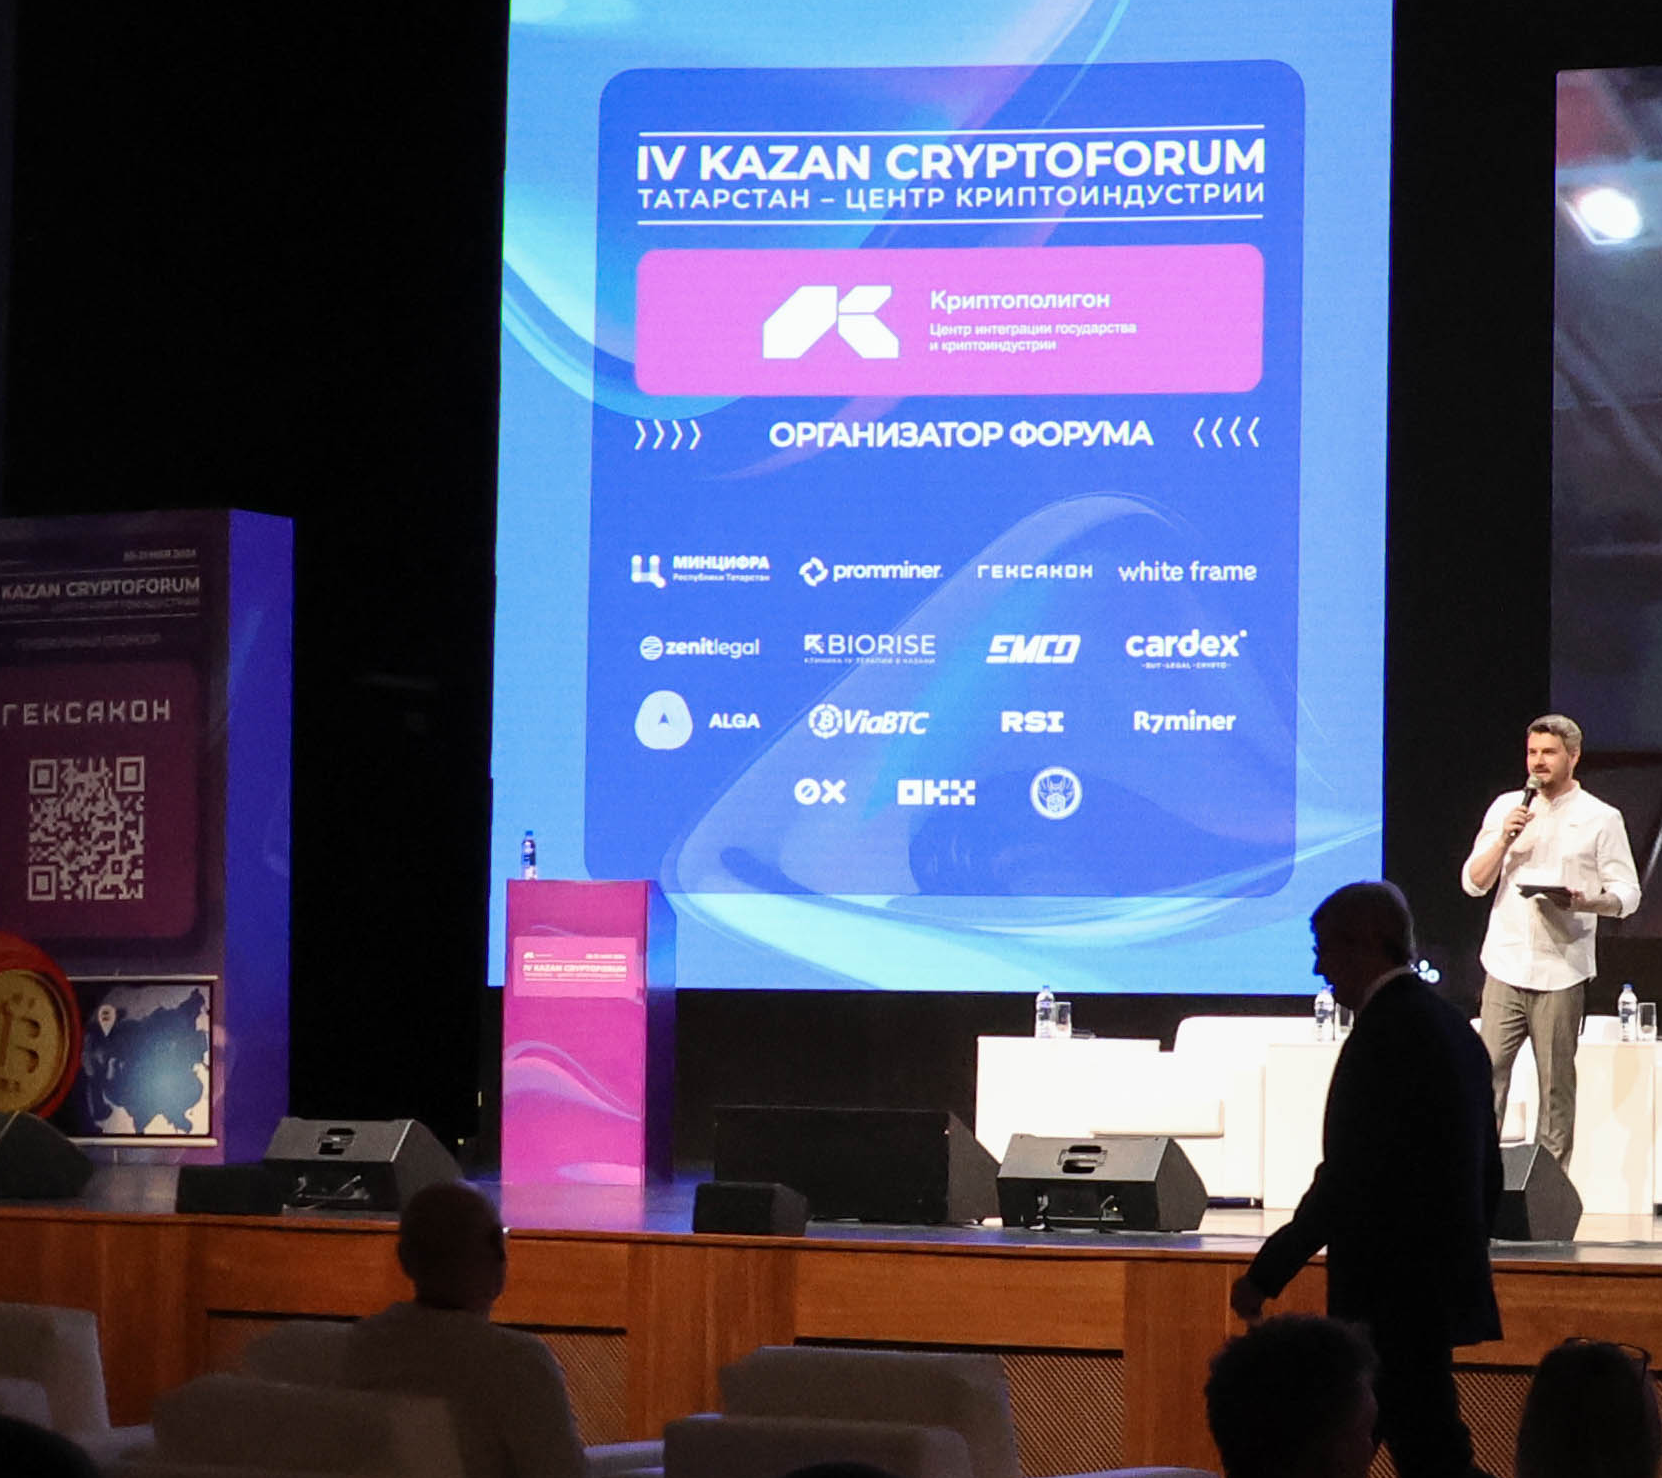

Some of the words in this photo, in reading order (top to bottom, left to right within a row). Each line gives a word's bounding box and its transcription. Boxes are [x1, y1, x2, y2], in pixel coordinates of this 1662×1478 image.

[636, 144, 685, 182] IV
[699, 141, 871, 182] KAZAN
[885, 137, 1266, 181] CRYPTOFORUM
[637, 186, 811, 210] ТАТАРСТАН
[845, 184, 946, 212] ЦЕНТР
[955, 180, 1266, 212] КРИПТОИНДУСТРИИ
[929, 287, 1111, 314] Криптополигон
[975, 322, 1052, 339] интеграции
[1055, 320, 1137, 338] государства
[768, 420, 1004, 448] ОРГАНИЗАТОР
[1008, 418, 1154, 448] ФОРУМА
[672, 555, 771, 572] МИНЦИФРА
[832, 559, 942, 583] promminer
[976, 563, 1094, 579] ГЕКСАКОН
[1117, 560, 1185, 582] white
[1188, 559, 1258, 582] frame
[1, 581, 61, 601] KAZAN
[65, 575, 201, 597] CRYPTOFORUM
[664, 636, 761, 660] zenitlegal
[827, 633, 937, 655] BIORISE
[1125, 628, 1241, 658] cardex
[2, 697, 171, 726] ГЕКСАКОН
[708, 712, 761, 730] ALGA
[842, 709, 930, 736] ViaBTC
[1000, 710, 1065, 734] RSI
[1133, 708, 1237, 735] R7miner
